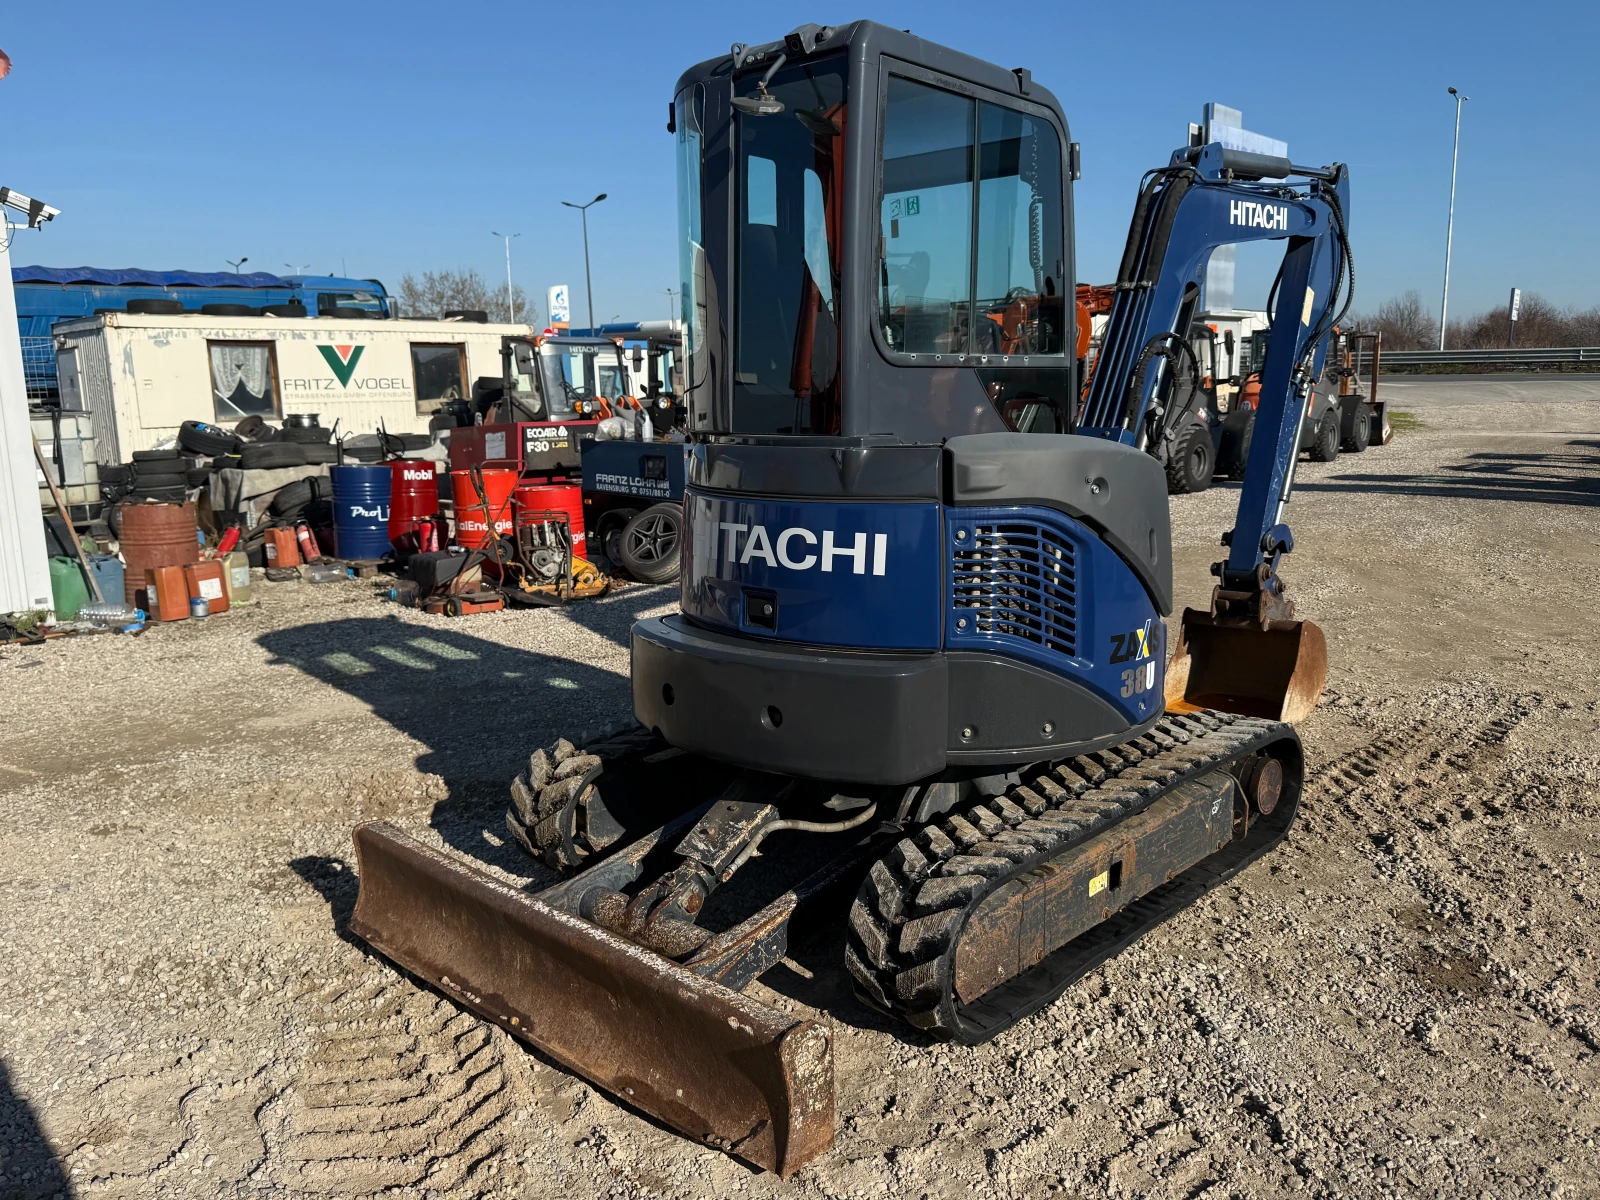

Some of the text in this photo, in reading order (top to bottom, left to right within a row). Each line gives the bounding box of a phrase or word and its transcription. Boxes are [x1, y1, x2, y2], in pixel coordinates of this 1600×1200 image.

[1229, 199, 1288, 231] HITACHI
[569, 345, 599, 353] HITACHI
[283, 377, 411, 391] FRITZ VOGEL
[526, 427, 558, 438] ECOAIR
[526, 440, 550, 453] F30
[403, 469, 433, 481] Mobil
[595, 473, 628, 485] FRANZ
[629, 477, 656, 487] LOHR
[596, 483, 630, 493] RAVENSBURG
[1109, 618, 1160, 665] ZAXIS
[1120, 660, 1156, 698] 38U
